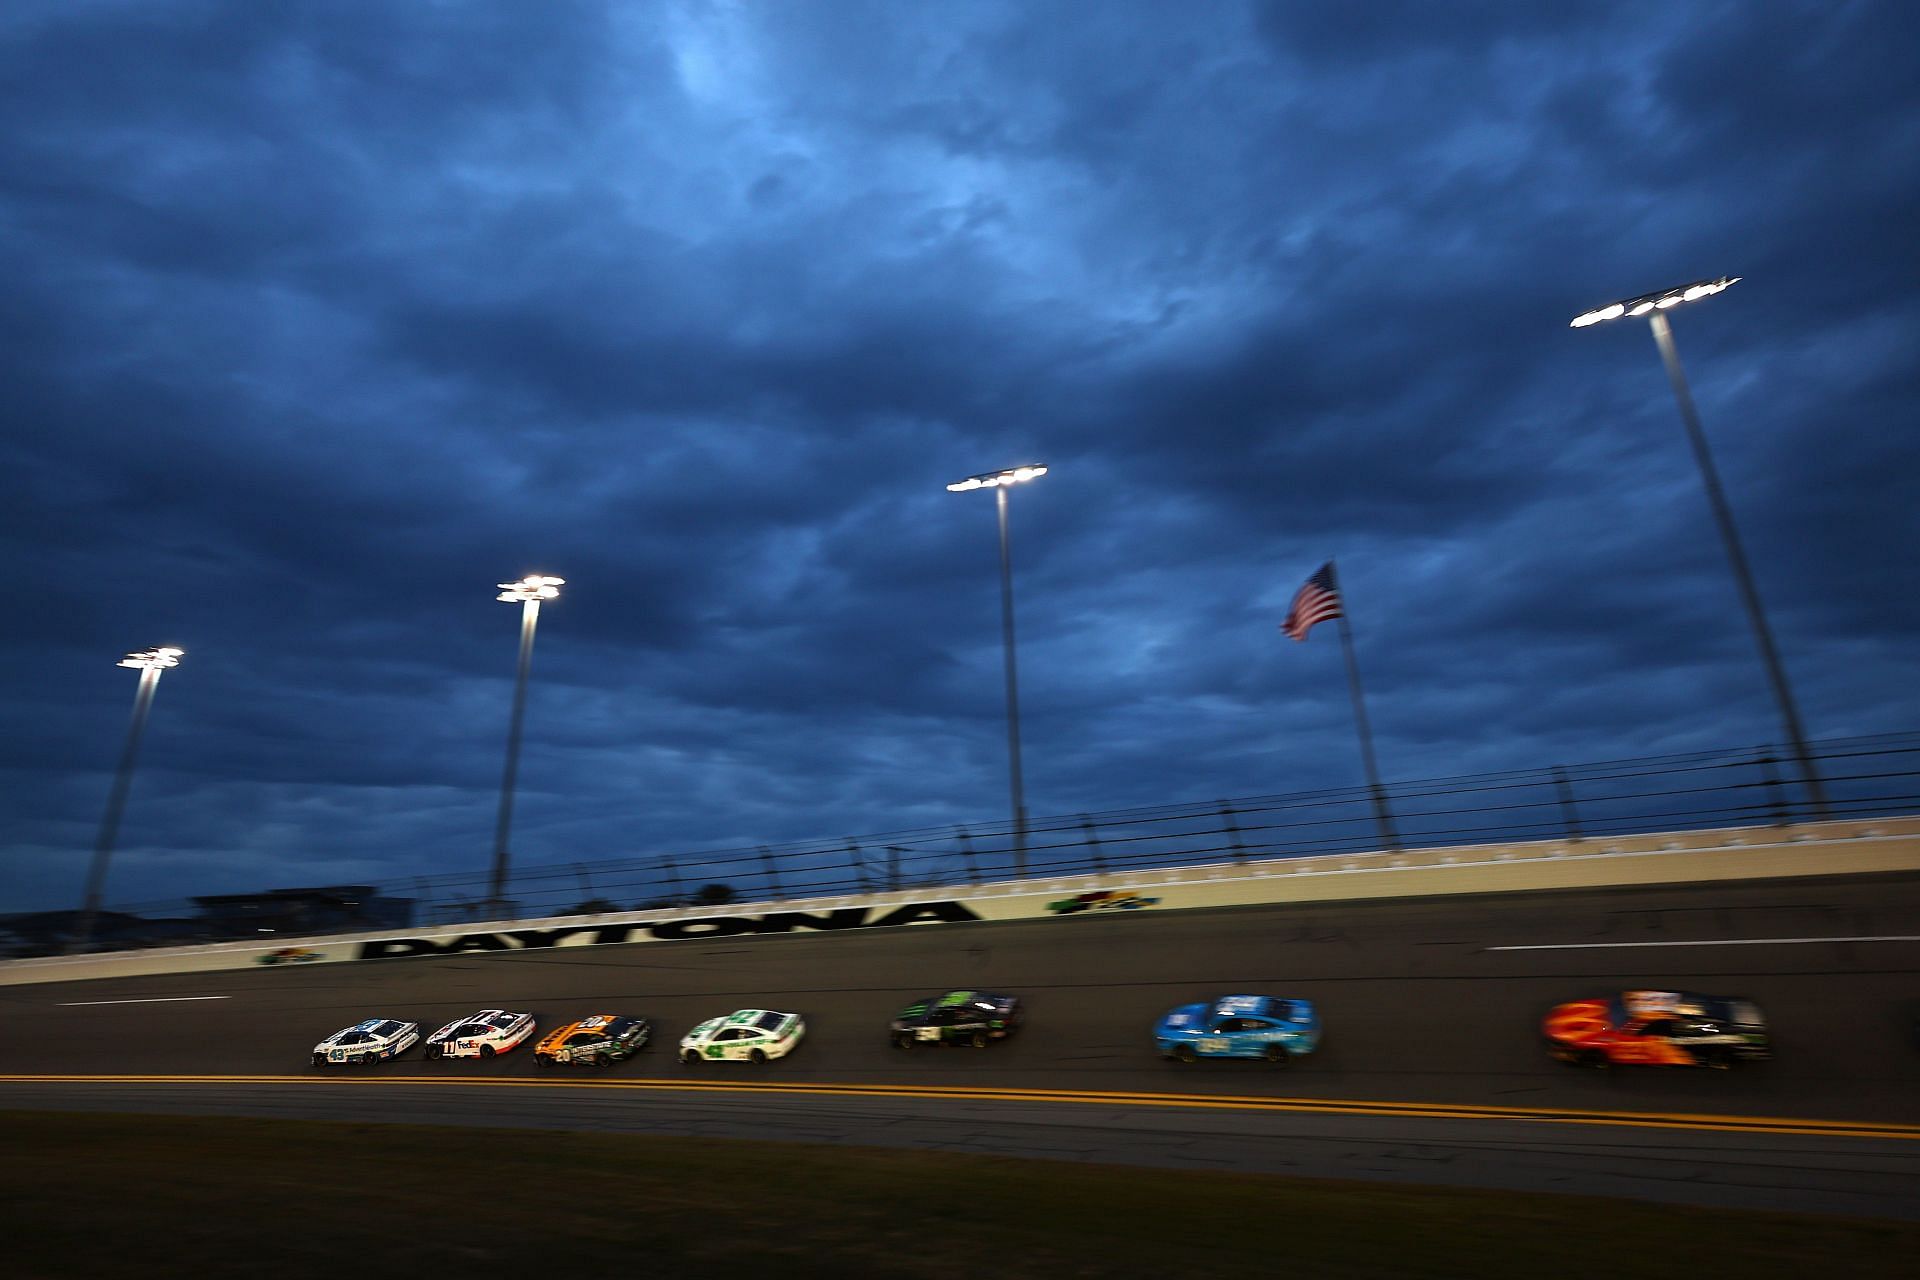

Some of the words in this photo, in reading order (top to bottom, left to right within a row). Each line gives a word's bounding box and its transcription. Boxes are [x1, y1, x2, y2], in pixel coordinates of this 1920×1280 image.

[358, 901, 985, 958] DAYTONA
[443, 1041, 455, 1054] 11
[457, 1039, 480, 1049] FedEx
[329, 1048, 345, 1061] 43
[555, 1049, 571, 1062] 20
